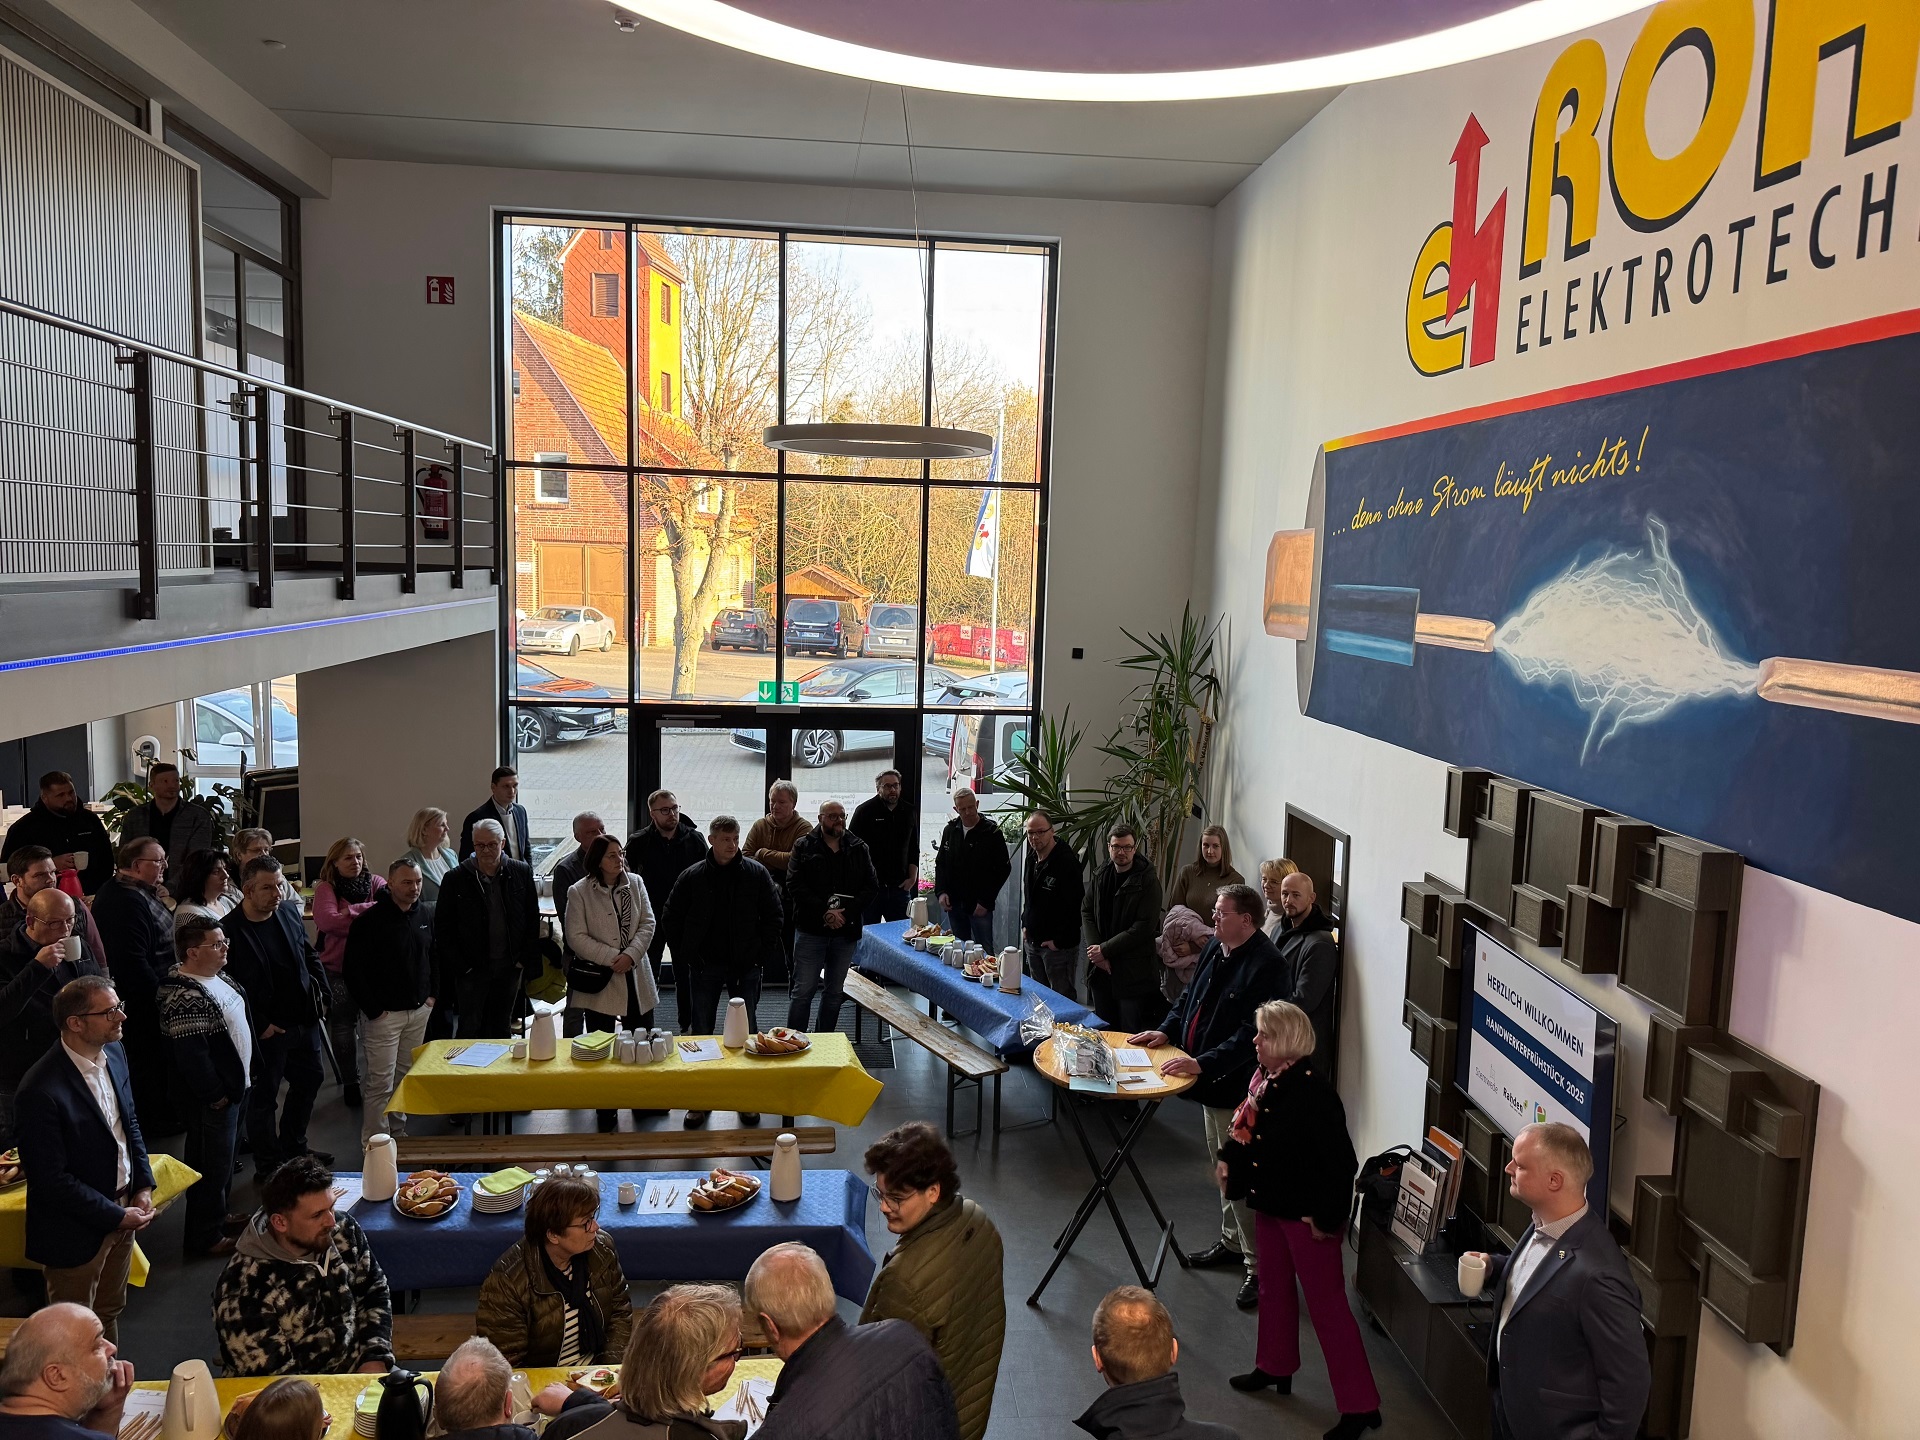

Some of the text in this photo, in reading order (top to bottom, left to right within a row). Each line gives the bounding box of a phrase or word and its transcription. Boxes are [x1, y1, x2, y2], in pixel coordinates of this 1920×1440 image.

[1515, 163, 1920, 355] ELEKTROTECH
[1351, 497, 1383, 531] denn
[1387, 487, 1424, 519] ohne
[1430, 475, 1487, 517] Strom
[1494, 453, 1552, 514] läuft
[1487, 972, 1584, 1058] HERZLICH WILLKOMMEN
[1485, 1014, 1585, 1105] HANDWERKERFRÜHSTÜCK 2025
[1503, 1087, 1524, 1113] Rahden
